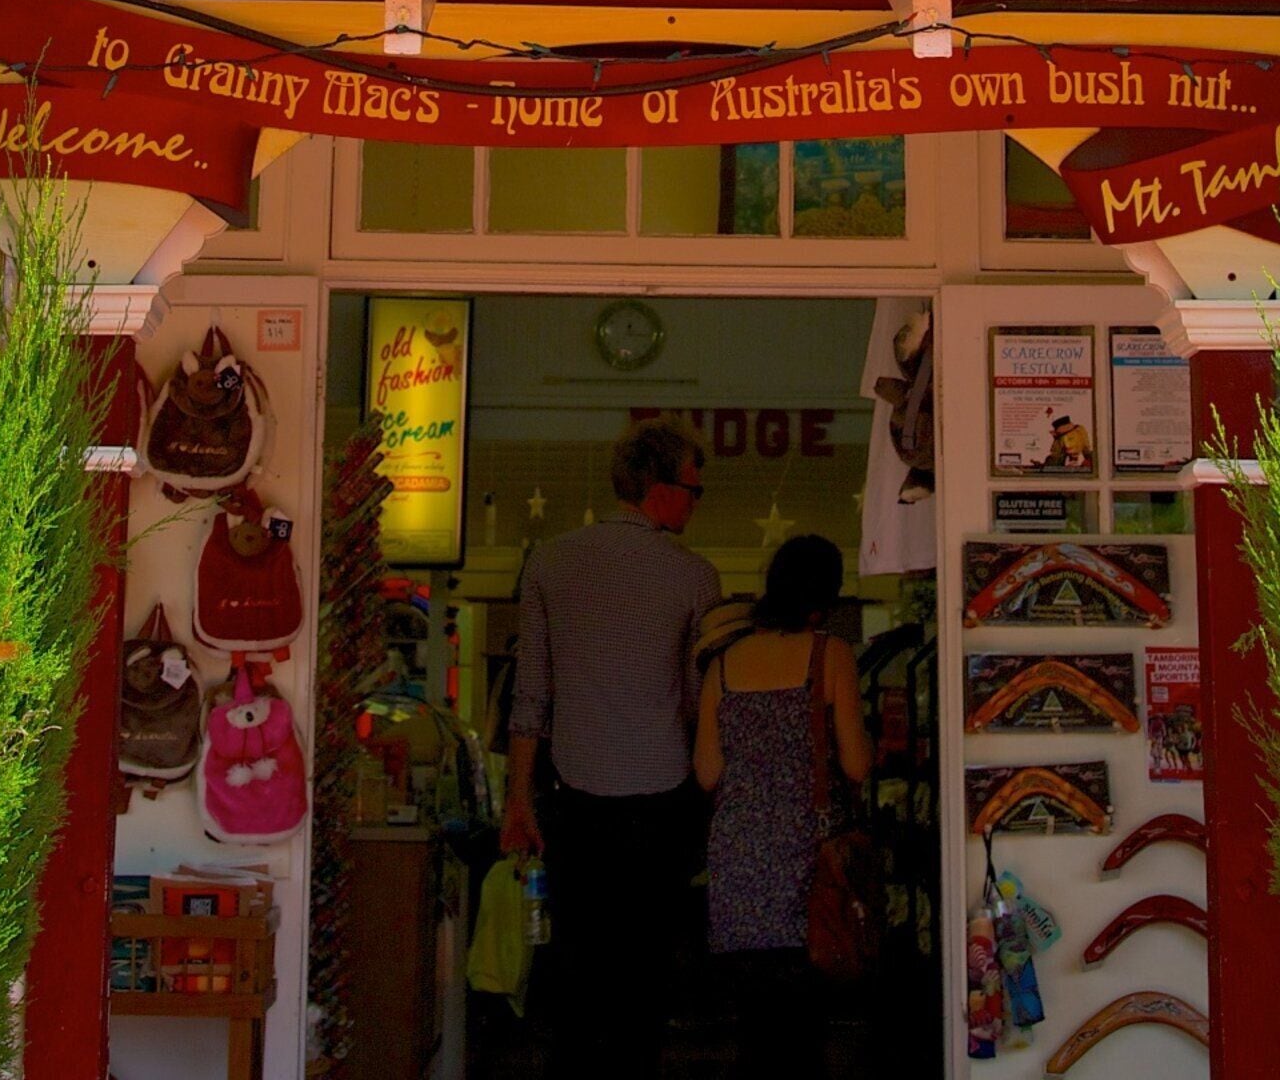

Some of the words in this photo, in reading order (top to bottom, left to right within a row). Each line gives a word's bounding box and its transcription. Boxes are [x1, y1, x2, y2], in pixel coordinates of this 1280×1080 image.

[88, 26, 130, 71] to
[163, 43, 310, 119] Granny
[323, 70, 440, 123] Mac's
[710, 68, 921, 122] Australia's
[950, 72, 1026, 107] own
[1047, 60, 1145, 106] bush
[1101, 177, 1182, 233] Mt.
[381, 326, 416, 362] old
[1002, 347, 1085, 360] SCARECROW
[377, 357, 454, 406] fashion
[1013, 363, 1079, 376] FESTIVAL
[382, 406, 409, 431] ce
[386, 420, 455, 448] cream
[999, 500, 1037, 508] GLUTEN
[1039, 500, 1063, 508] FREE
